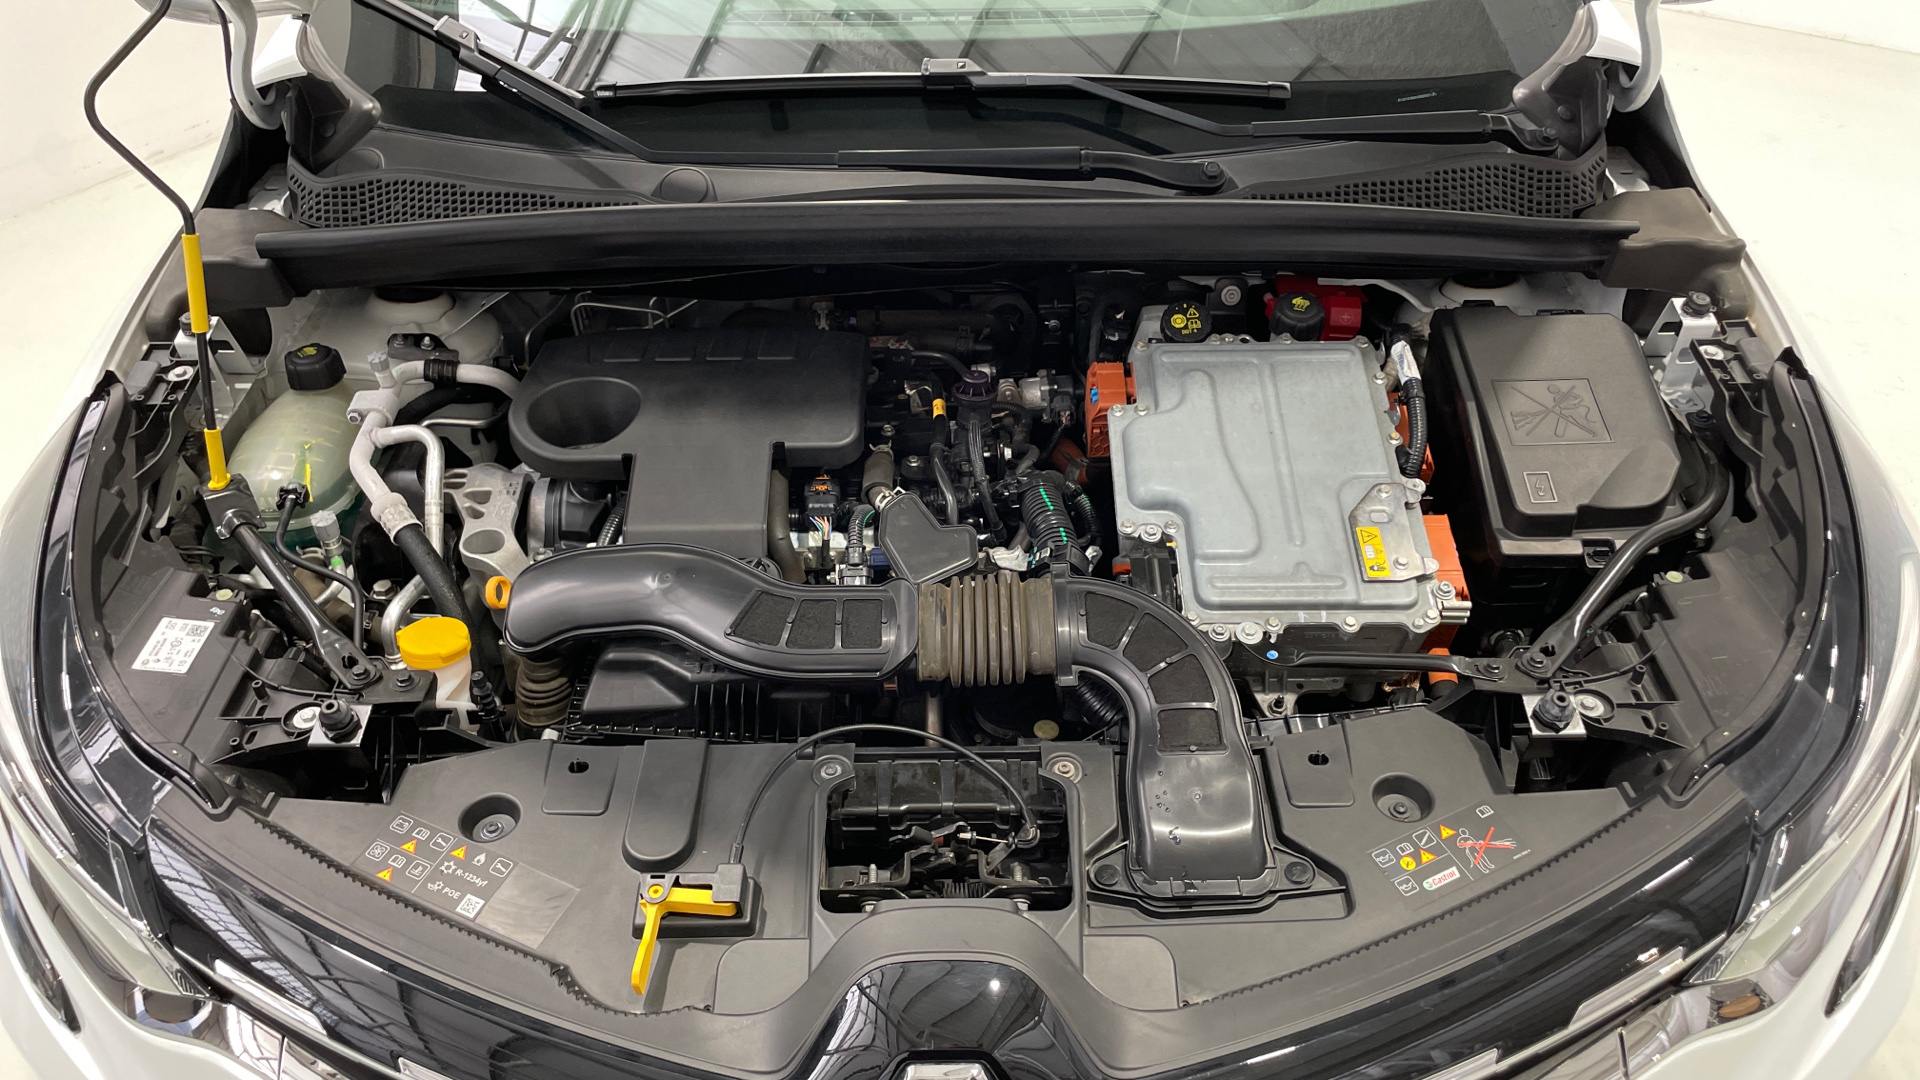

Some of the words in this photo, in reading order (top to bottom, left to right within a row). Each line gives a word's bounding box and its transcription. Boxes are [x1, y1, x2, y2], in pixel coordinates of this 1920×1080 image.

[455, 869, 488, 887] R-1234yf
[1433, 870, 1457, 885] Castrol
[442, 886, 462, 900] POE
